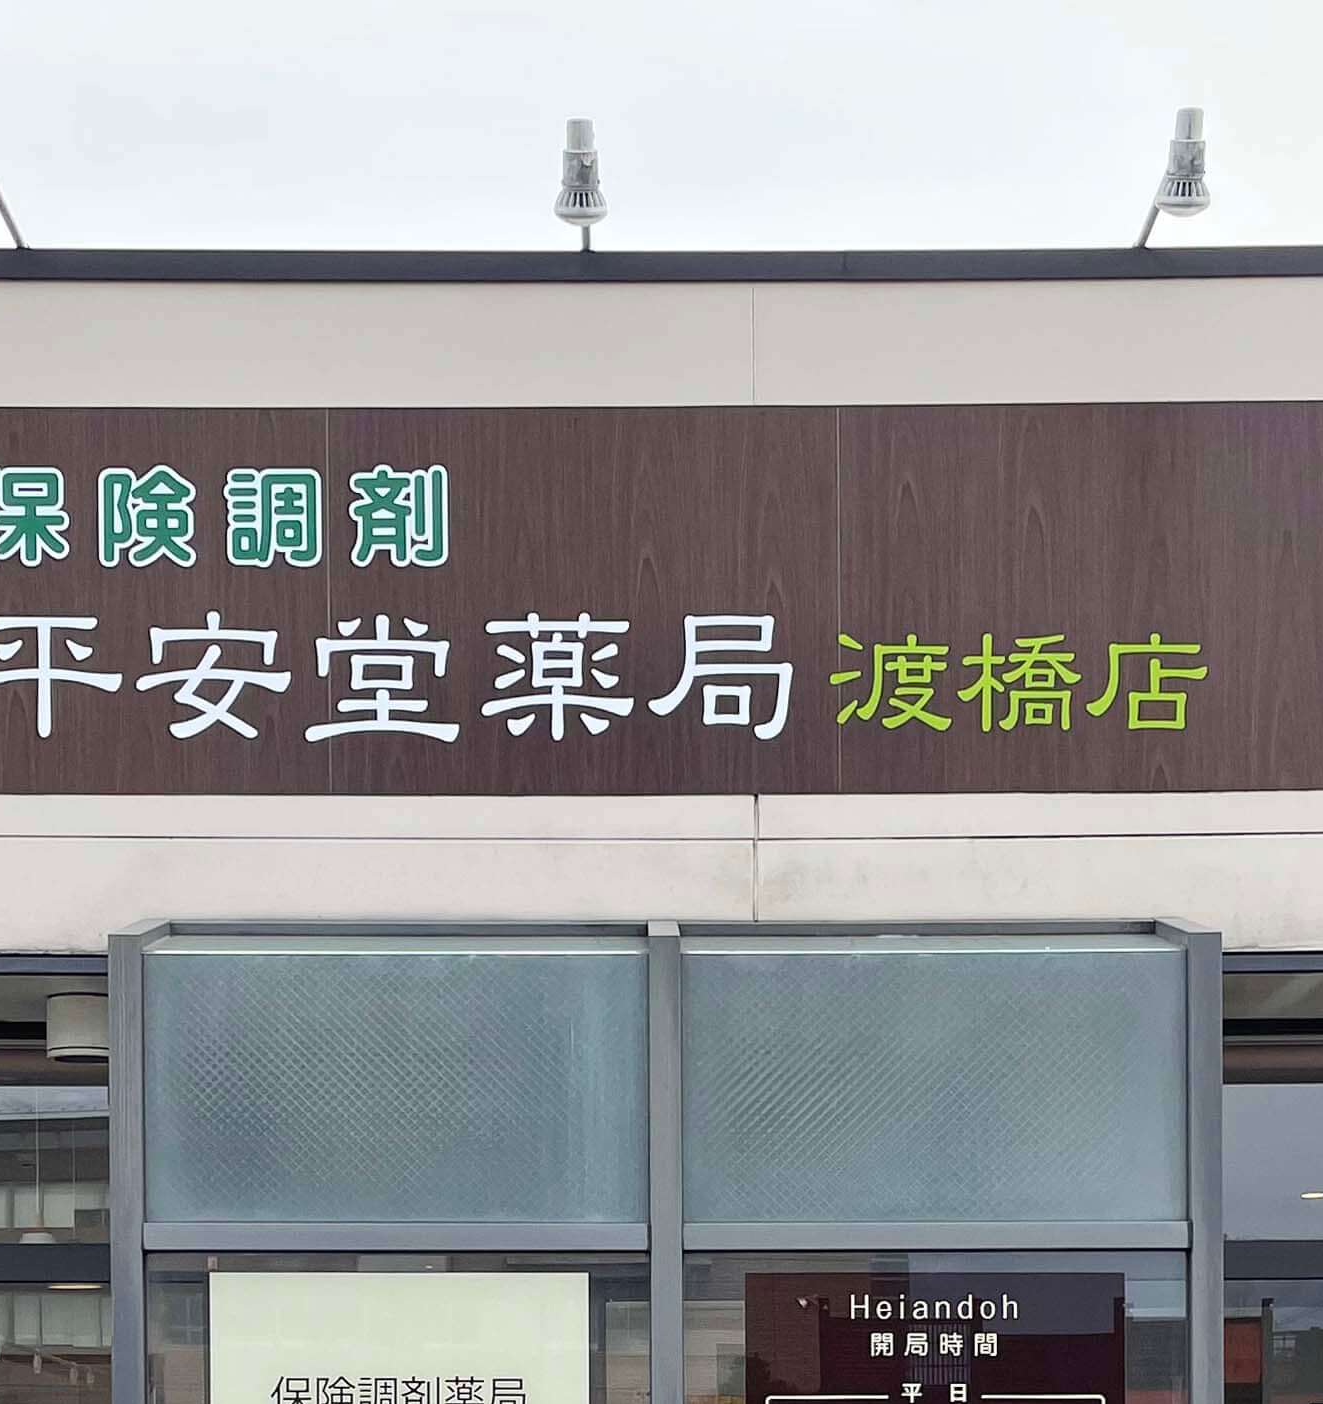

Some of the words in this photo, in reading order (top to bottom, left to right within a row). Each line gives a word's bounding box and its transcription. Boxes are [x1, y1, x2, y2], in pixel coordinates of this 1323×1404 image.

[828, 632, 1208, 734] 渡橋店
[849, 1294, 1019, 1320] Heiandoh
[870, 1333, 998, 1357] 開局時間
[900, 1383, 969, 1403] 平日
